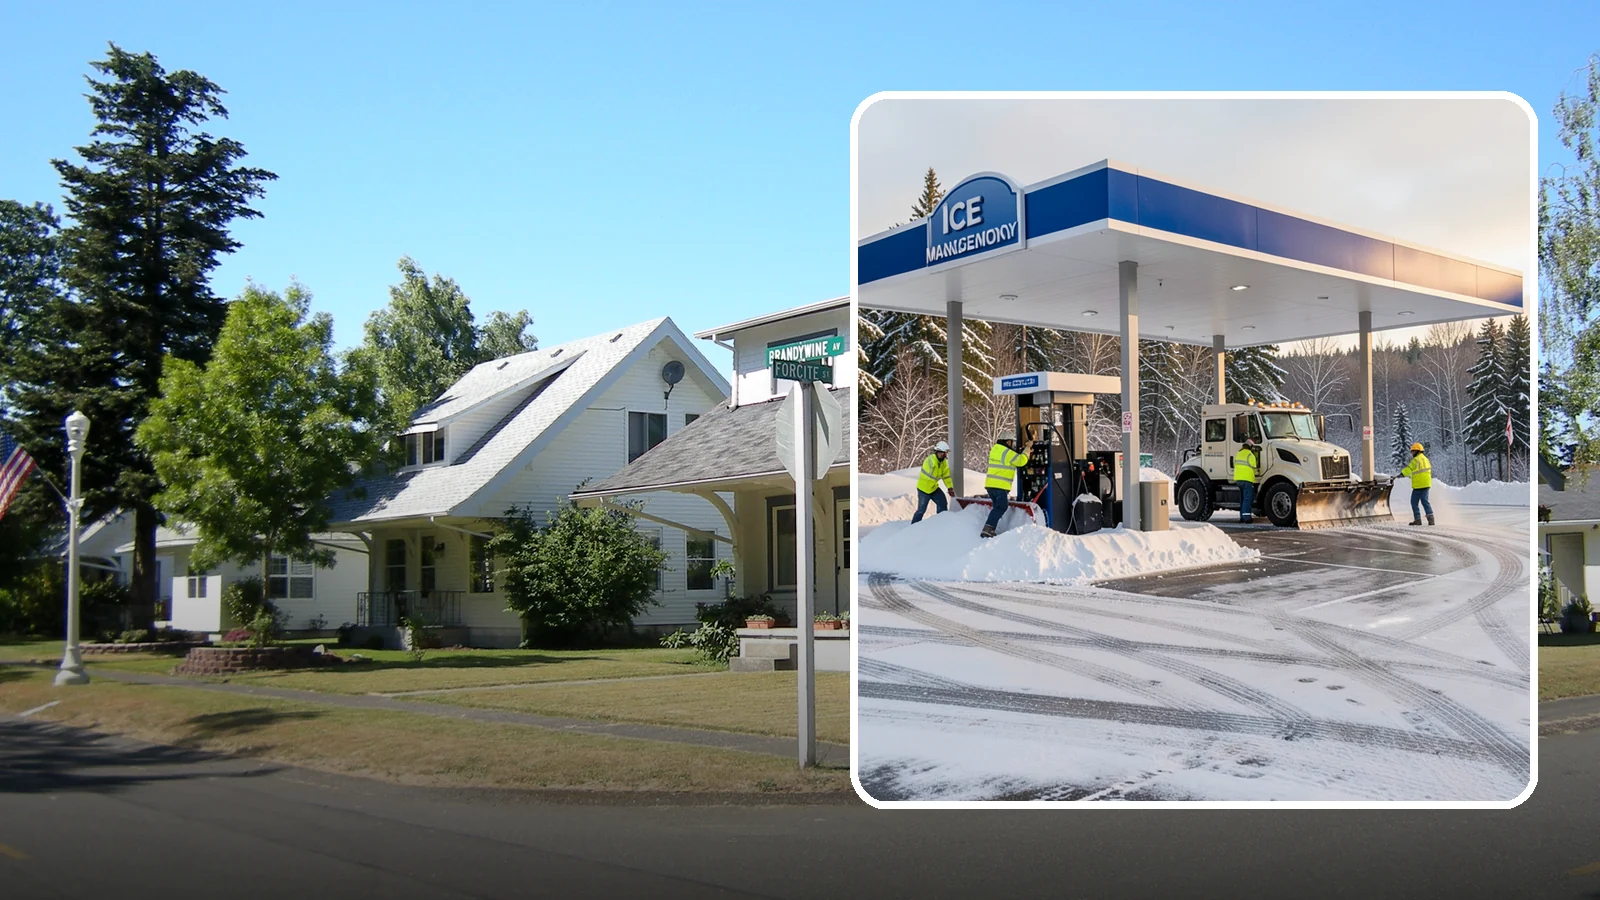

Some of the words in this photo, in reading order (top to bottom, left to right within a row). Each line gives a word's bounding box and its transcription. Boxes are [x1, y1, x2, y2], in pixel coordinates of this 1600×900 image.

[942, 195, 982, 235] ICE
[768, 341, 828, 364] BRANDYWINE
[832, 342, 841, 351] AV
[775, 362, 819, 380] FORCITE
